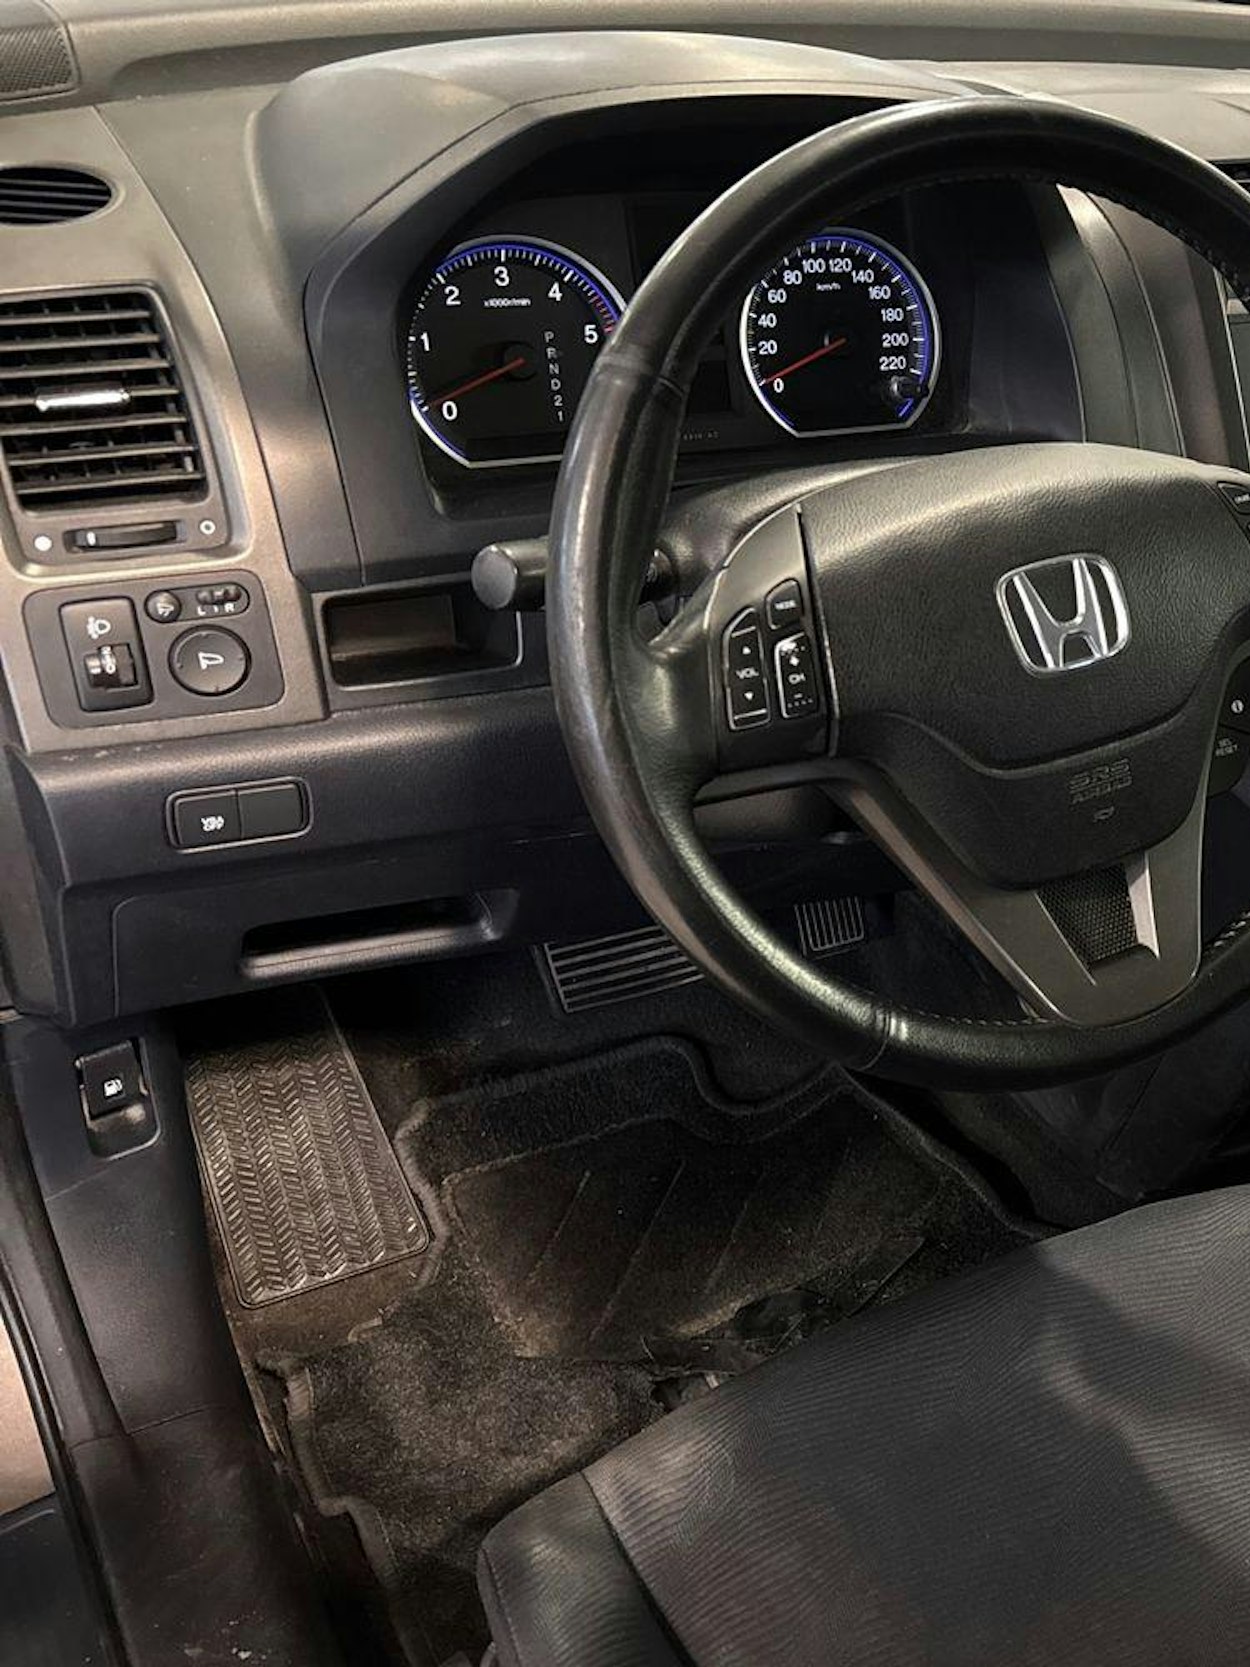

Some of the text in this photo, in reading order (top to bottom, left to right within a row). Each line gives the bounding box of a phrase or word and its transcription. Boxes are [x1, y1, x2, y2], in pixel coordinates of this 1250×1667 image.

[802, 258, 826, 274] 100
[829, 258, 852, 273] 120
[494, 266, 510, 287] 3
[783, 270, 803, 285] 80
[851, 269, 875, 284] 140
[444, 286, 461, 306] 2
[548, 283, 563, 302] 4
[768, 288, 787, 304] 60
[868, 286, 891, 300] 160
[758, 313, 777, 328] 40
[881, 307, 904, 322] 180
[420, 332, 430, 351] 1
[584, 324, 599, 344] 5
[882, 333, 909, 347] 200
[758, 340, 777, 355] 20
[879, 357, 907, 371] 220
[773, 378, 785, 394] 0
[442, 401, 458, 421] 0
[736, 667, 759, 680] VOL
